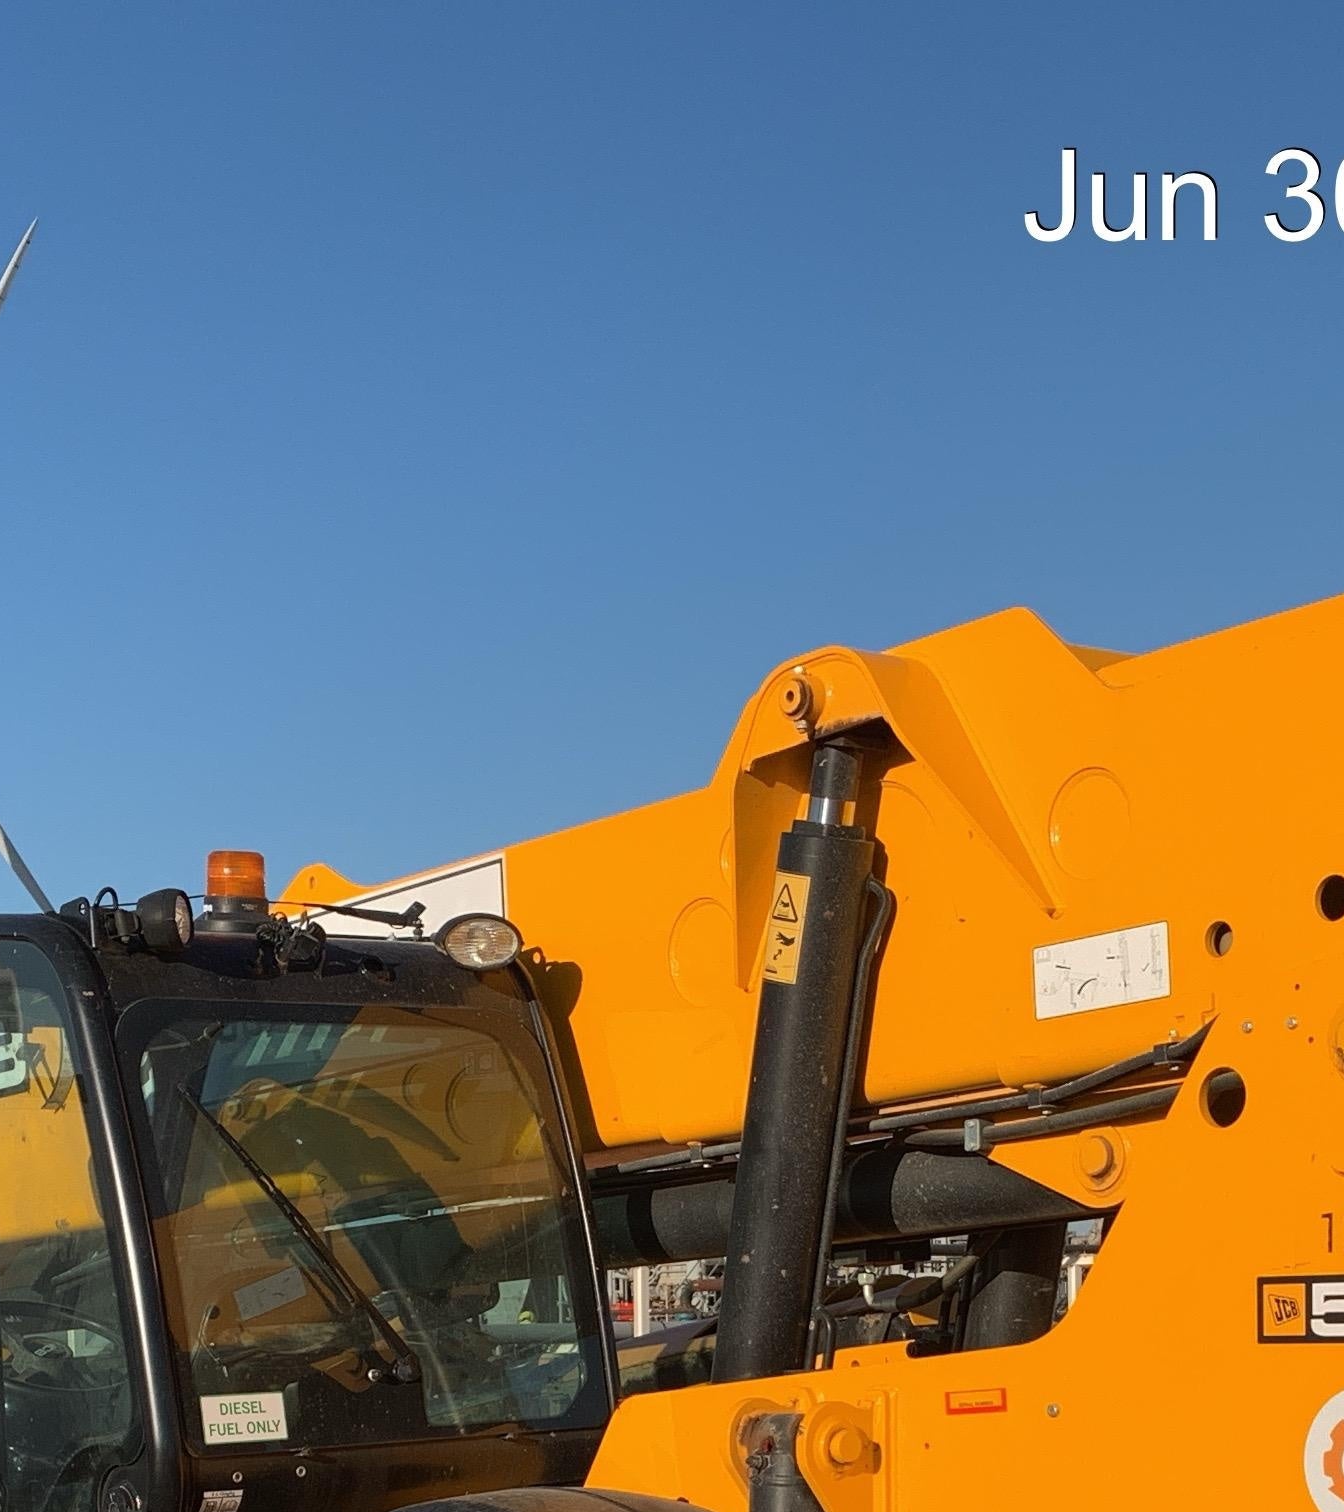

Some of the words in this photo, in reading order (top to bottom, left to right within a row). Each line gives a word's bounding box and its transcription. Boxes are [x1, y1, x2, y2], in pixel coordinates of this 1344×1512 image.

[1273, 1296, 1299, 1322] JCB
[219, 1401, 266, 1416] DIESEL
[209, 1422, 243, 1436] FUEL
[246, 1420, 281, 1435] ONLY
